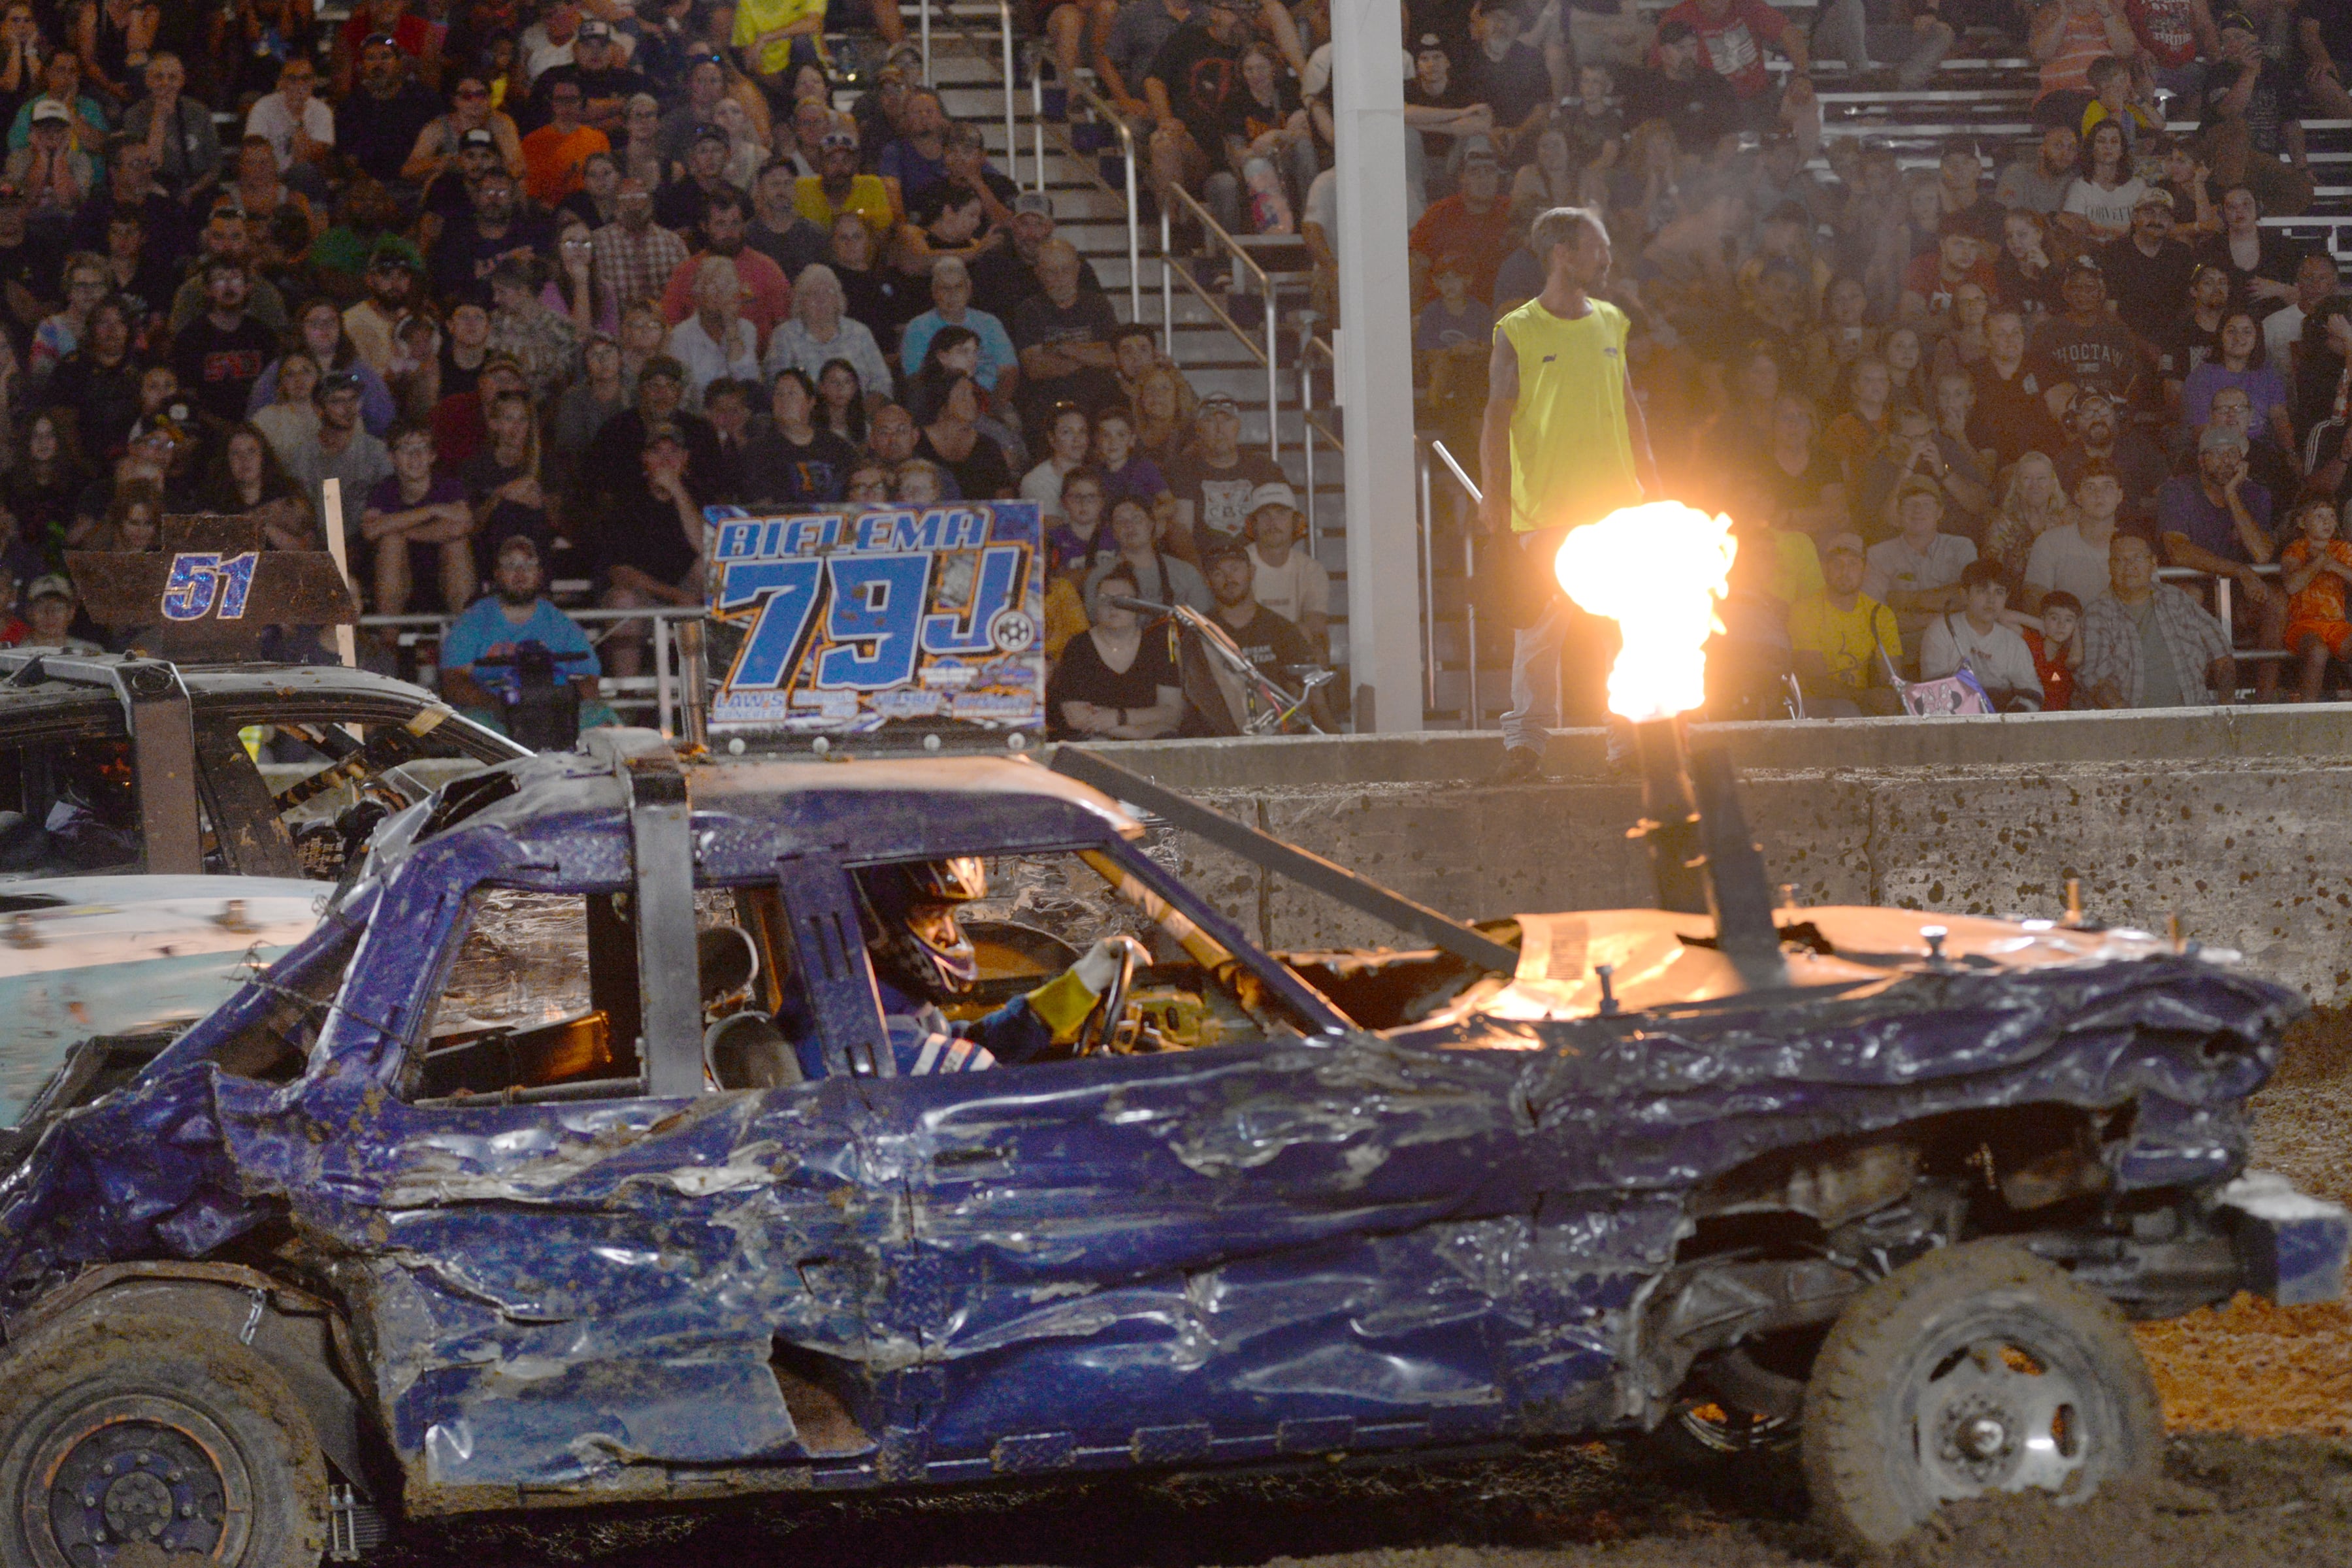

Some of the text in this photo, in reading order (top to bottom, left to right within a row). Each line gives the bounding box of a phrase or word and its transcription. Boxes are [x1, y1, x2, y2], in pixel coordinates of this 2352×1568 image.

[714, 506, 990, 562] BIELEMA
[161, 551, 260, 621] 51
[719, 546, 1020, 690] 79J
